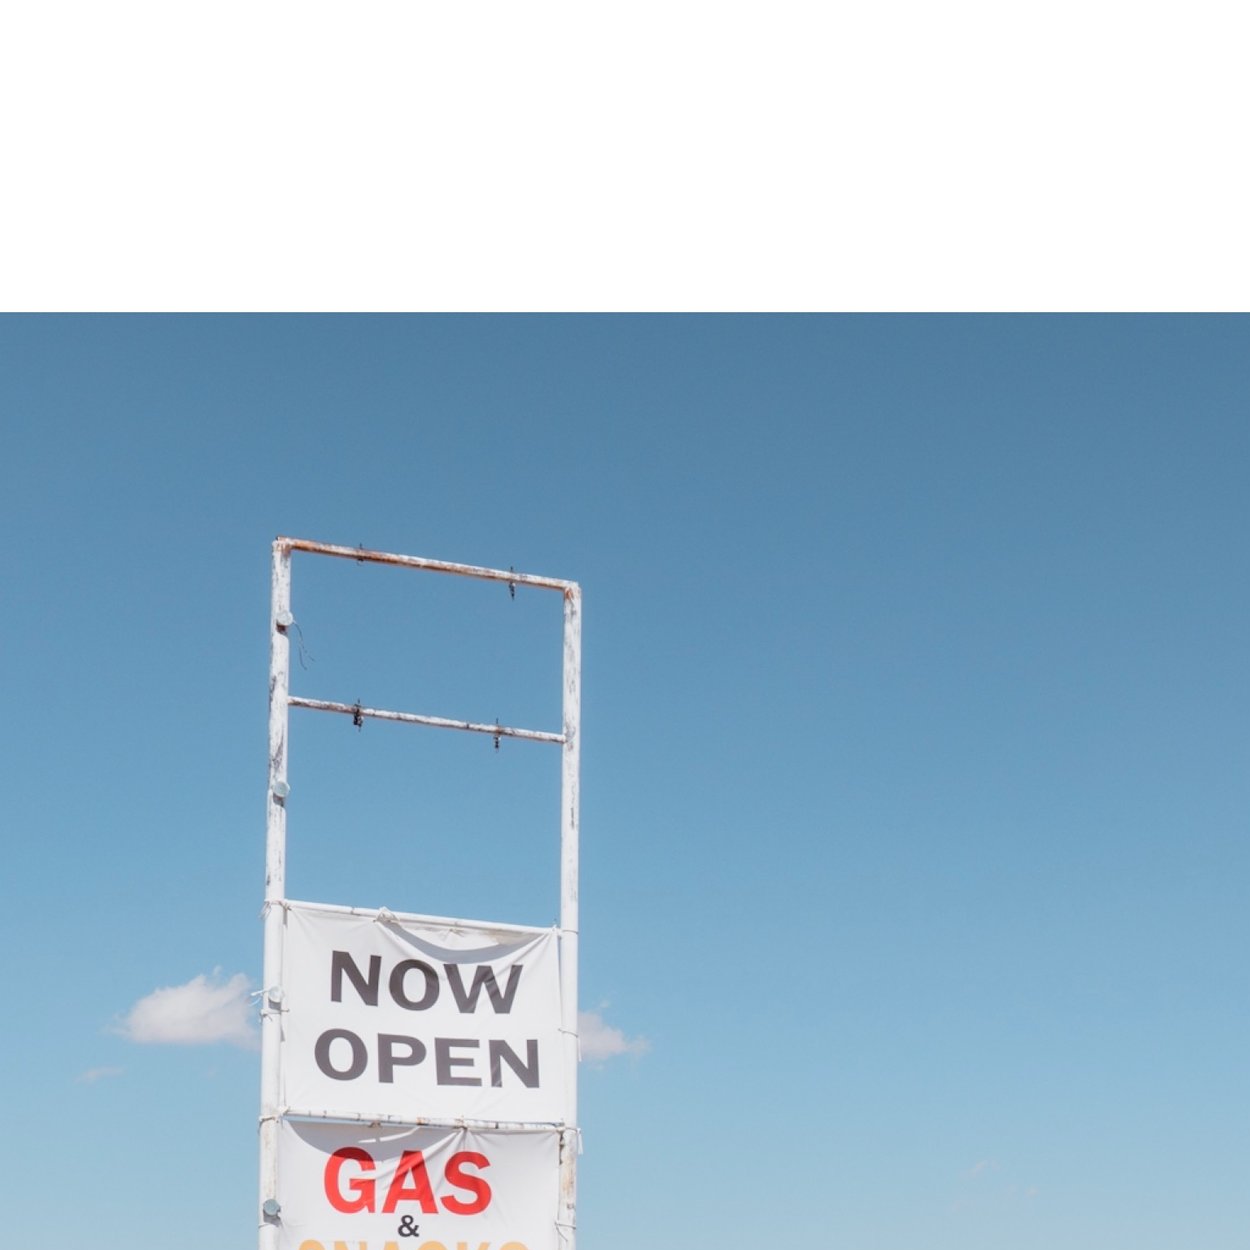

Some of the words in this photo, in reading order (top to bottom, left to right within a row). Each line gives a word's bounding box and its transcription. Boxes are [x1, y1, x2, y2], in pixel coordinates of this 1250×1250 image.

[331, 950, 523, 1014] NOW
[314, 1028, 540, 1088] OPEN
[323, 1146, 493, 1216] GAS
[397, 1214, 420, 1238] &
